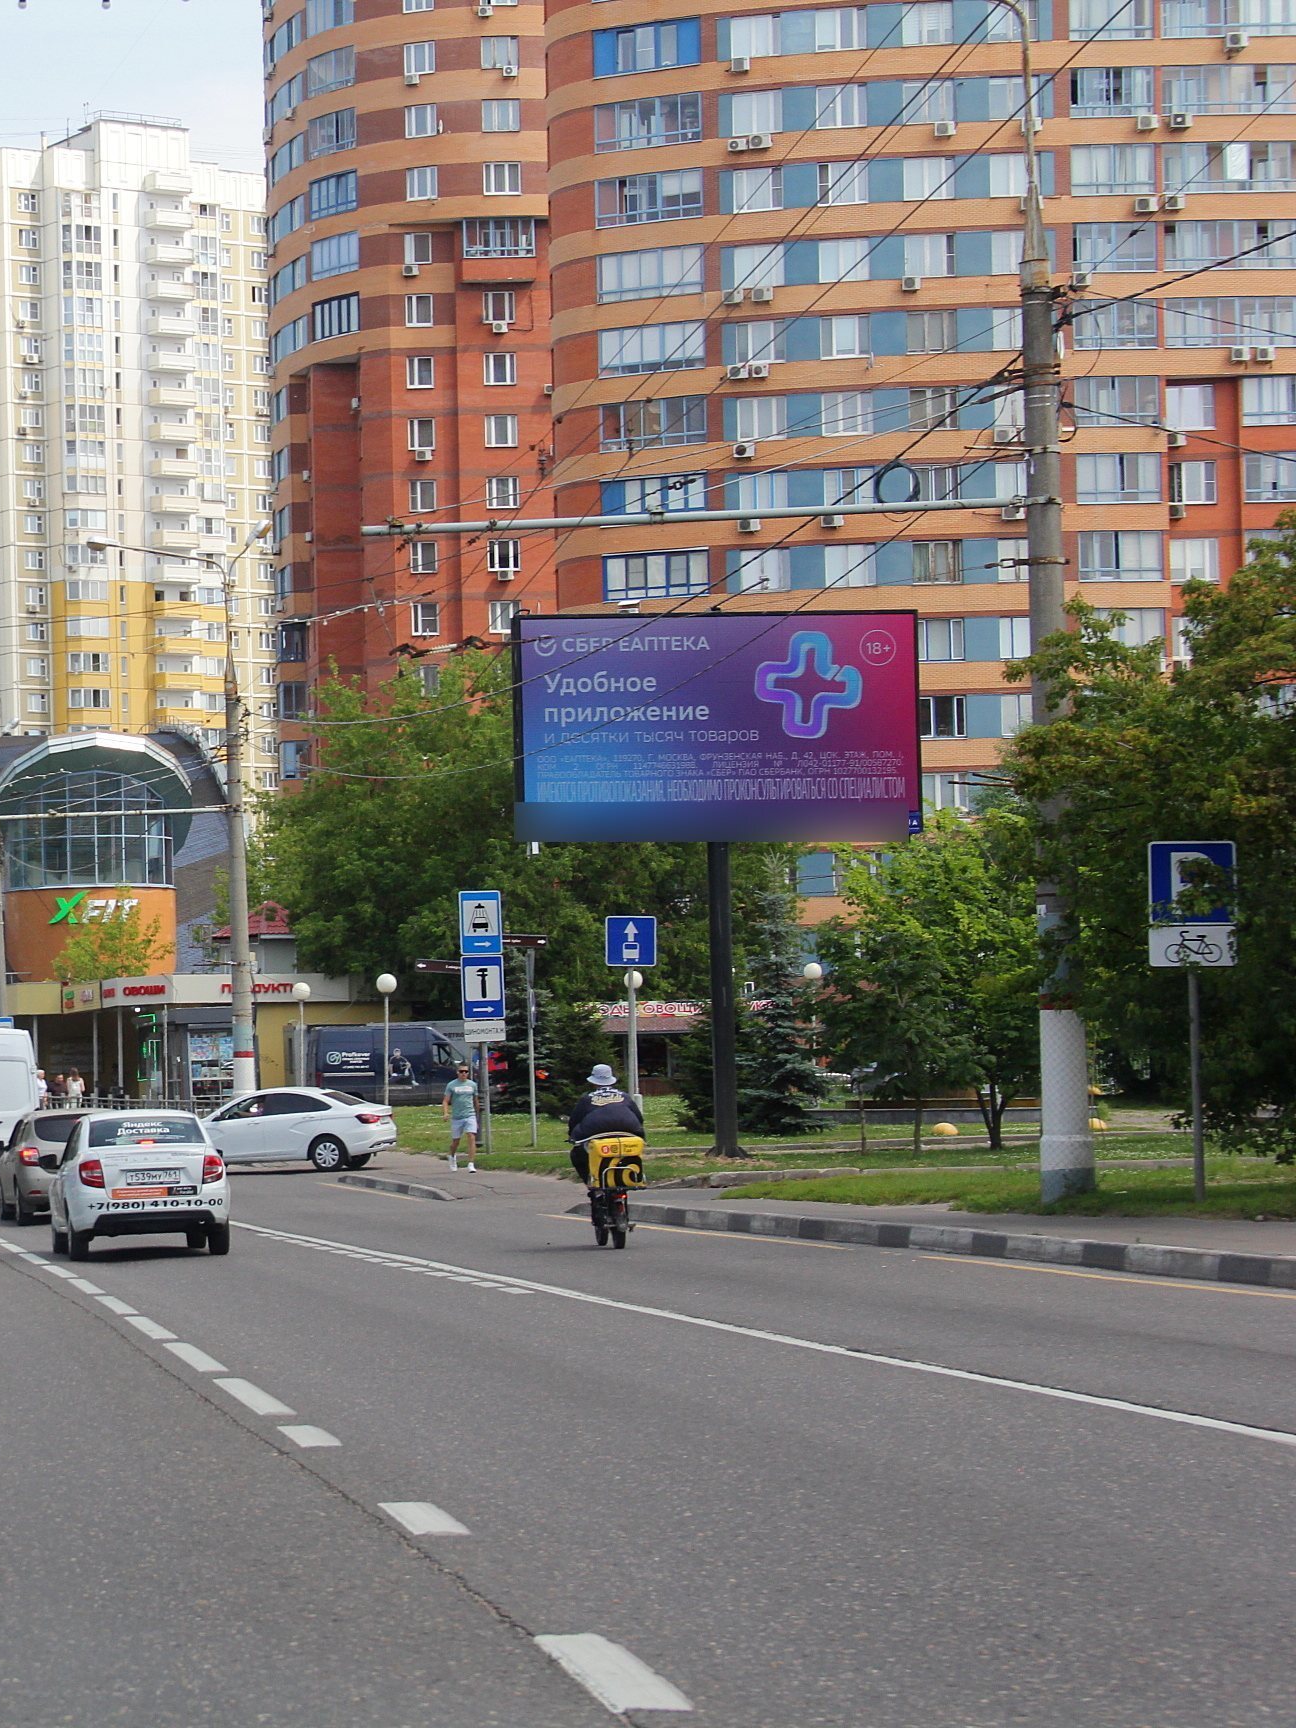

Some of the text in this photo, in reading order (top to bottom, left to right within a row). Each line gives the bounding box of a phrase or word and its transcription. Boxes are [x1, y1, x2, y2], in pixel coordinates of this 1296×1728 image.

[561, 636, 711, 653] СБЕР ЕАПТЕКА
[865, 642, 891, 655] 18+
[543, 671, 657, 696] Удобное
[543, 705, 710, 728] приложение
[544, 729, 760, 747] и десятки тысяч товаров
[699, 753, 762, 761] ФРУНЗЕНСКАЯ
[712, 761, 760, 769] ЛИЦЕНЗИЯ
[624, 770, 674, 778] ТОВАРНОГО
[675, 770, 704, 778] ЗНАКА
[738, 768, 757, 776] ПАО
[808, 767, 830, 776] ОГРН
[667, 779, 723, 802] НЕОБХОДИМО
[724, 777, 826, 801] ПРОКОНСУЛЬТИРОВАТЬСЯ
[827, 777, 839, 800] СО
[839, 776, 906, 801] СПЕЦИАЛИСТОМ
[117, 1127, 170, 1136] Доставка
[121, 1121, 163, 1129] Яндекс
[87, 1198, 223, 1211] +7(980) 410-10-00
